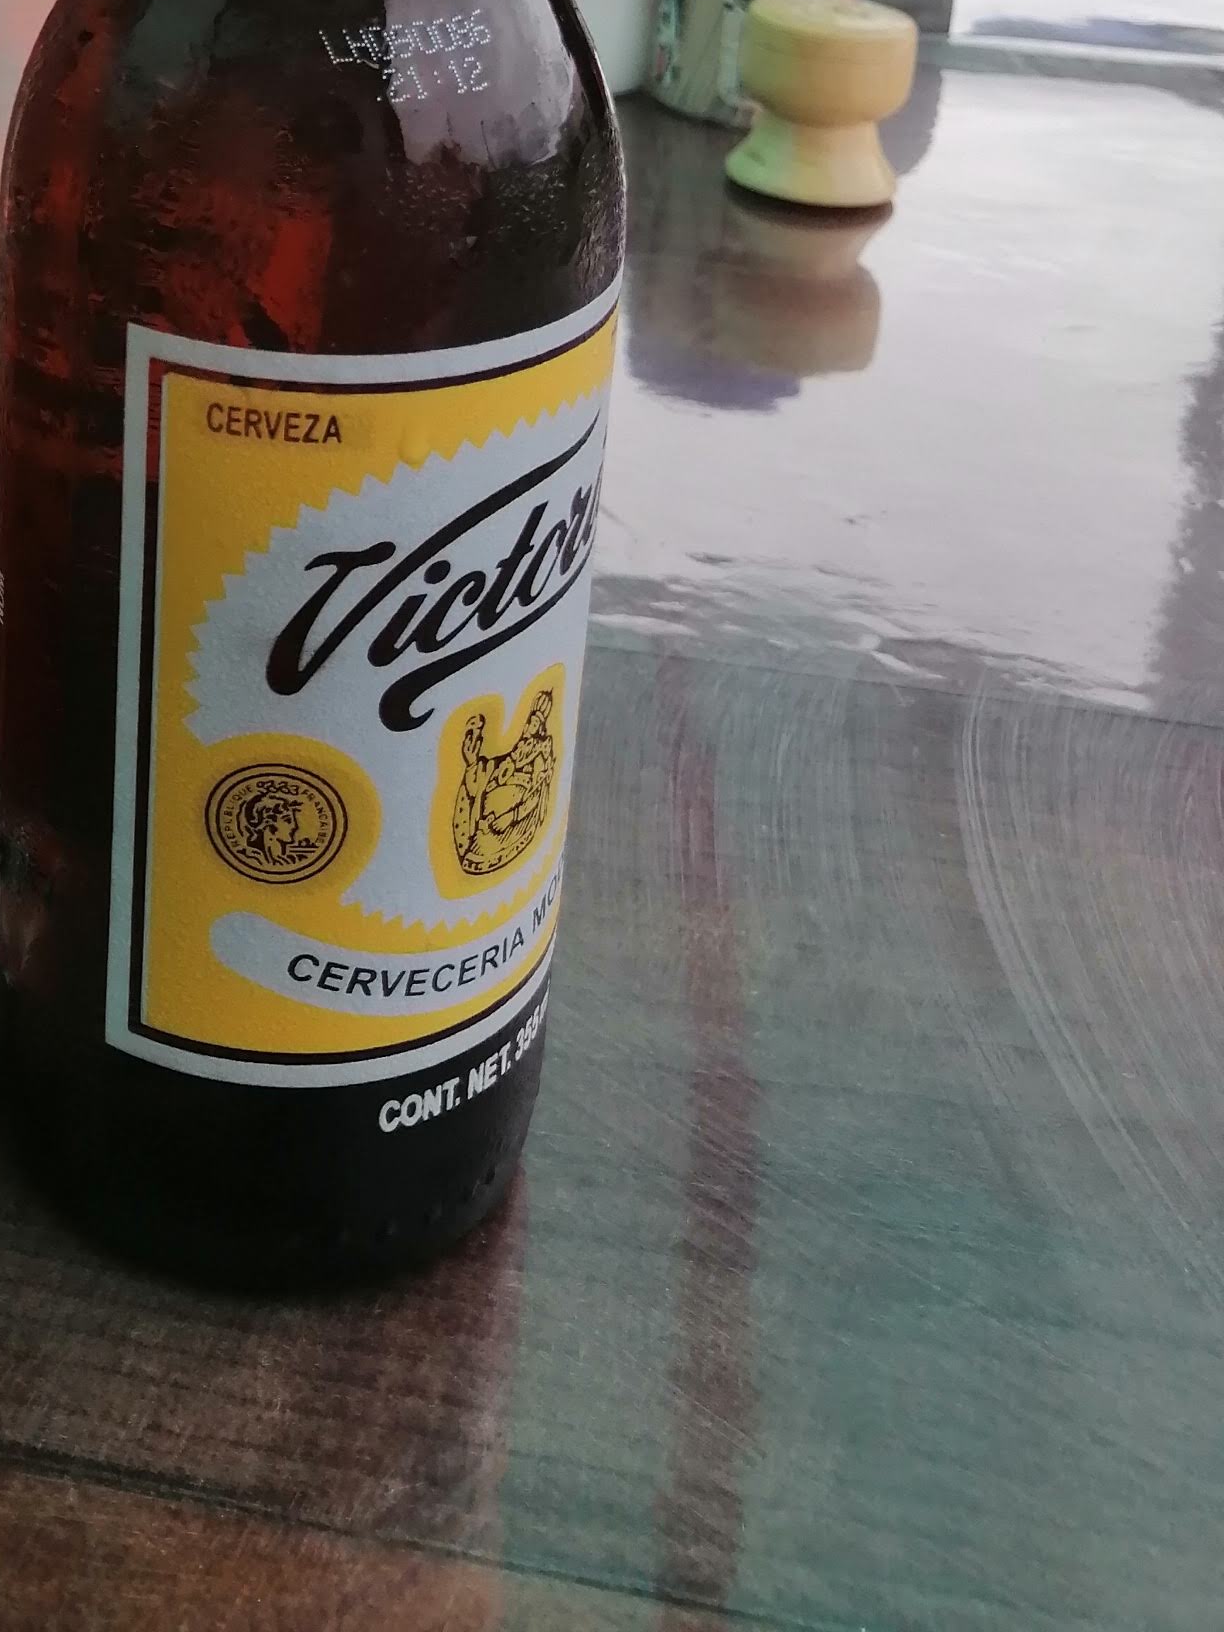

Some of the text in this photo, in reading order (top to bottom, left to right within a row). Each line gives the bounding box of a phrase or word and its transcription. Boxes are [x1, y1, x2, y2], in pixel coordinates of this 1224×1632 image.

[206, 402, 343, 444] CERVEZA
[286, 926, 525, 998] CERVECERIA
[378, 1077, 461, 1133] CONT.
[467, 1041, 513, 1100] NET.
